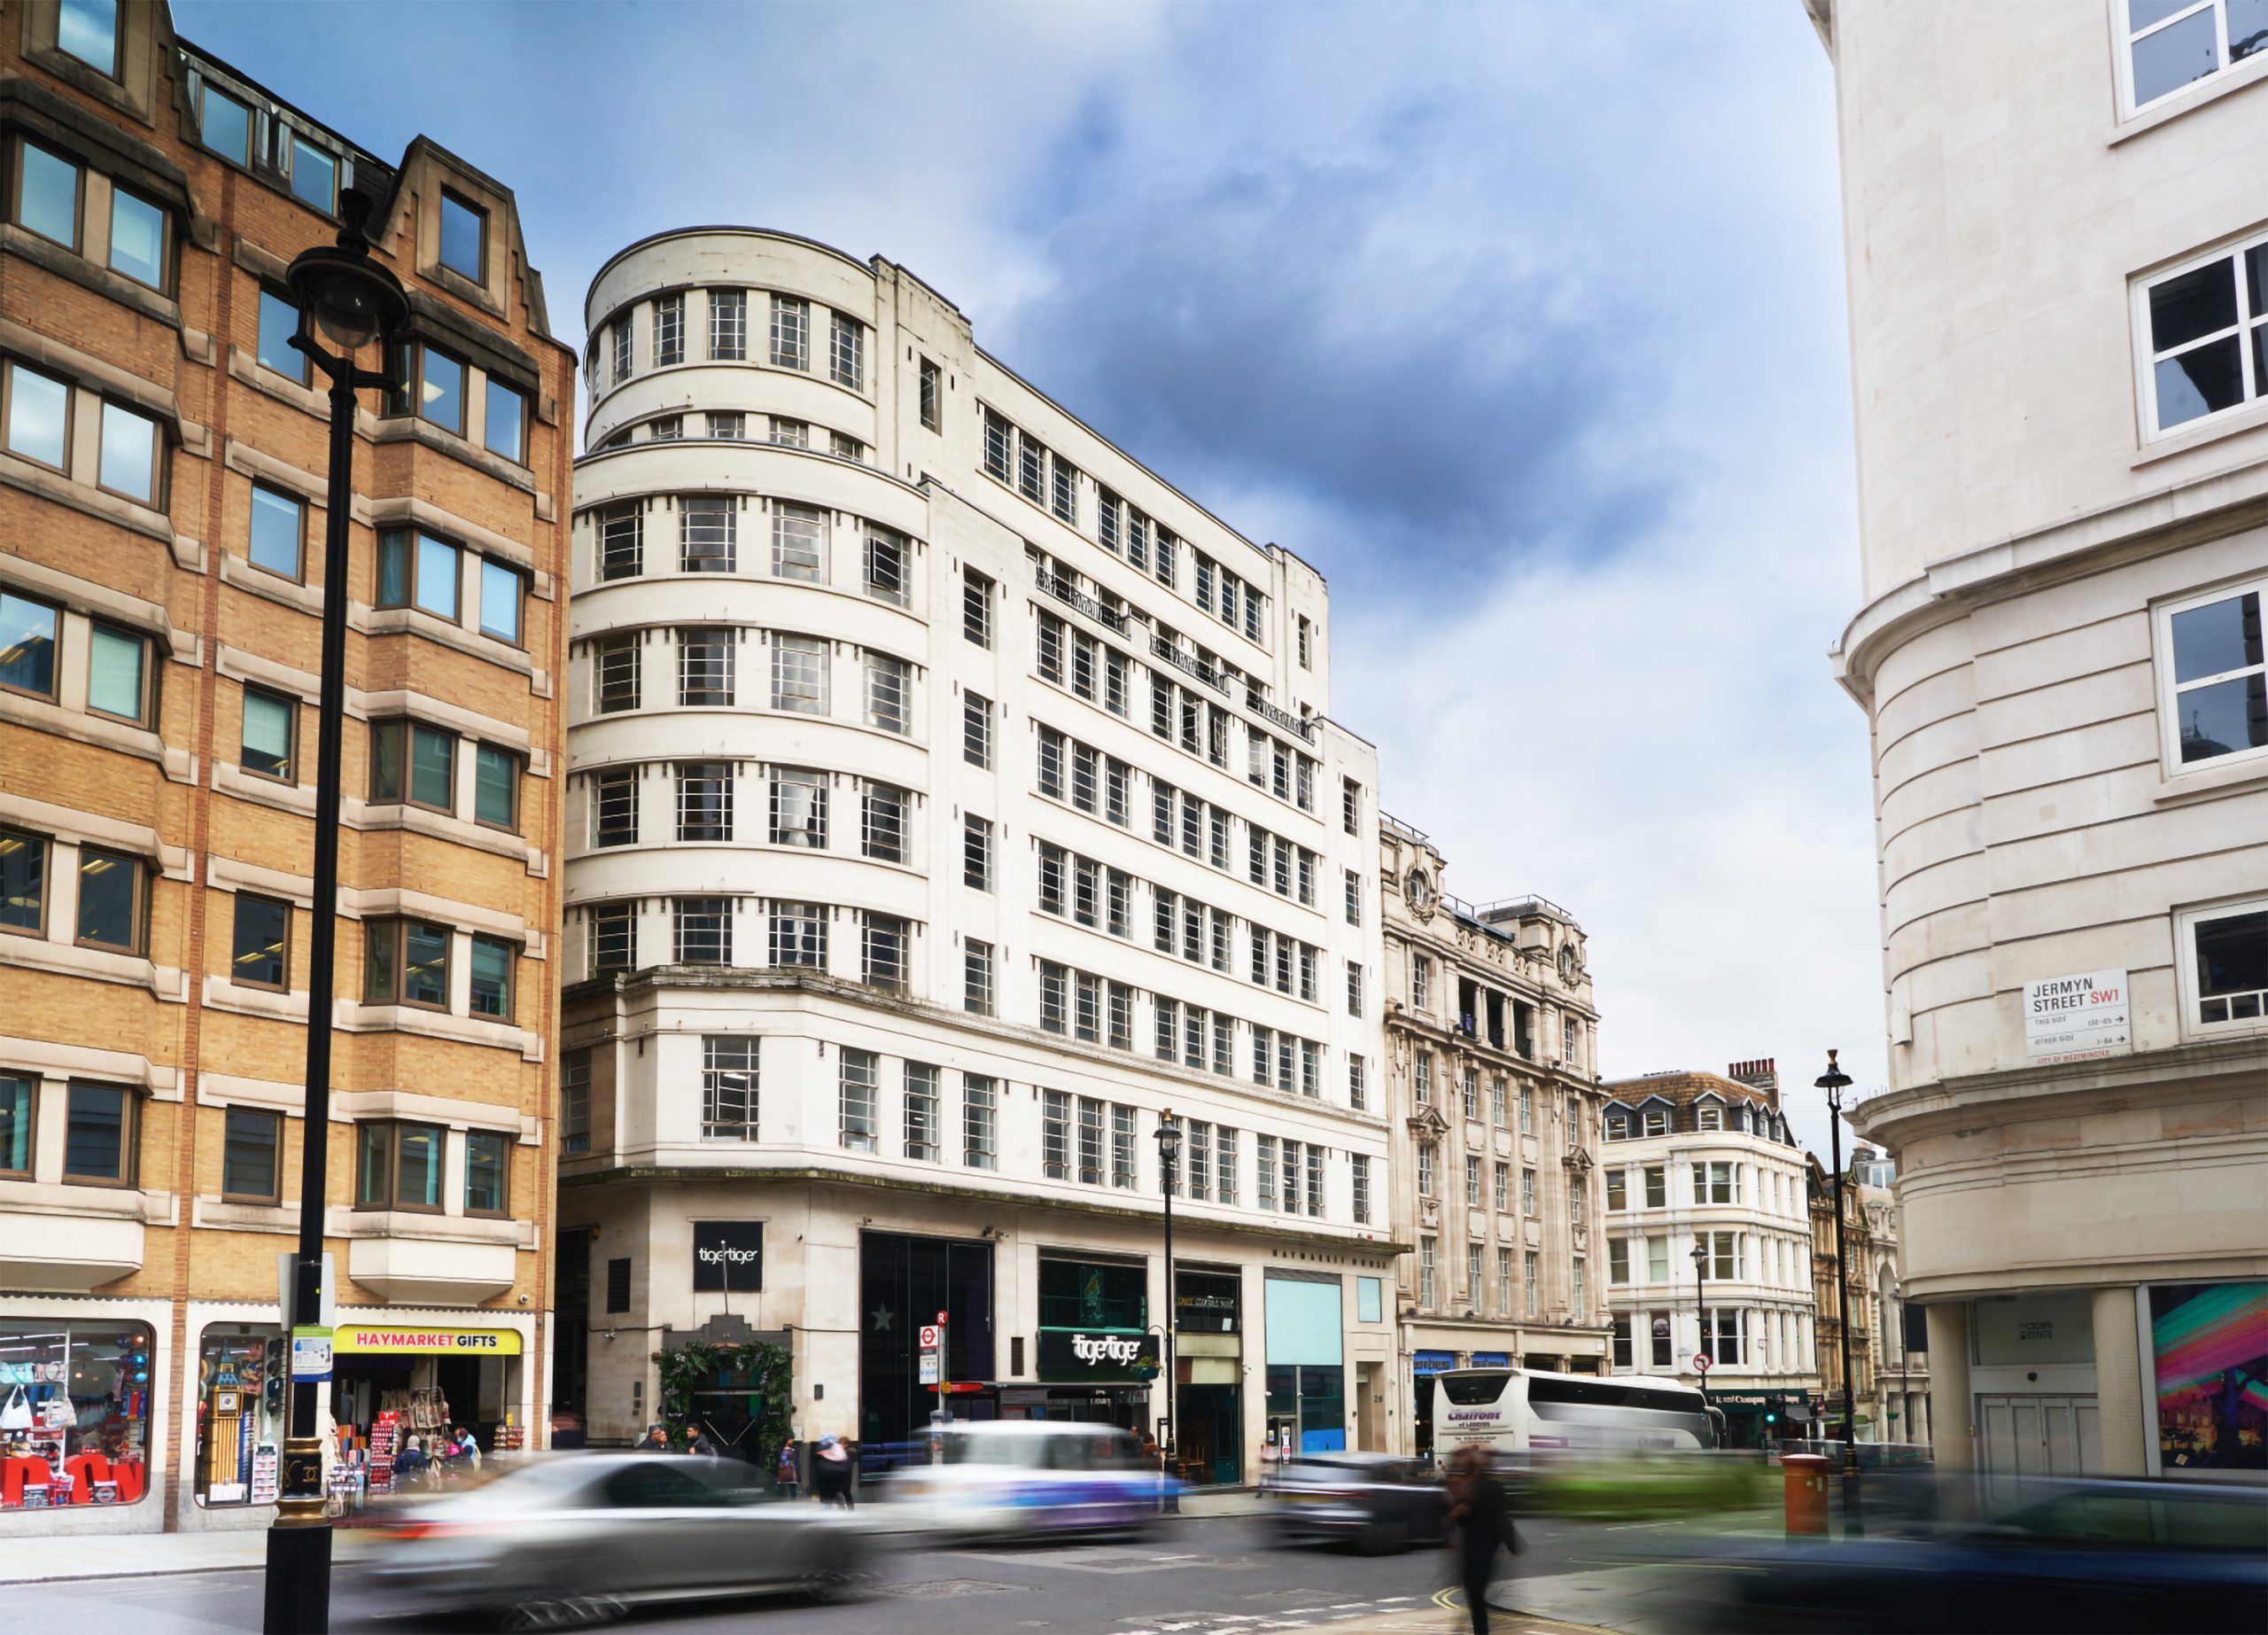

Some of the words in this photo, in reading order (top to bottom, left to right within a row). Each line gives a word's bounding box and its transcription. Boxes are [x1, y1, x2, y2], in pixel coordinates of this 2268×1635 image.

[2032, 977, 2093, 998] JERMYN
[2033, 993, 2085, 1012] STREET
[2090, 989, 2119, 1004] SW1
[2034, 1036, 2057, 1046] OTHER
[2063, 1049, 2110, 1062] WESTMINSTER
[1272, 1248, 1345, 1265] HAYMARKET
[1352, 1257, 1386, 1270] HOUSE
[937, 1312, 945, 1323] R
[356, 1333, 454, 1346] HAYMARKET
[456, 1335, 497, 1347] GIFTS
